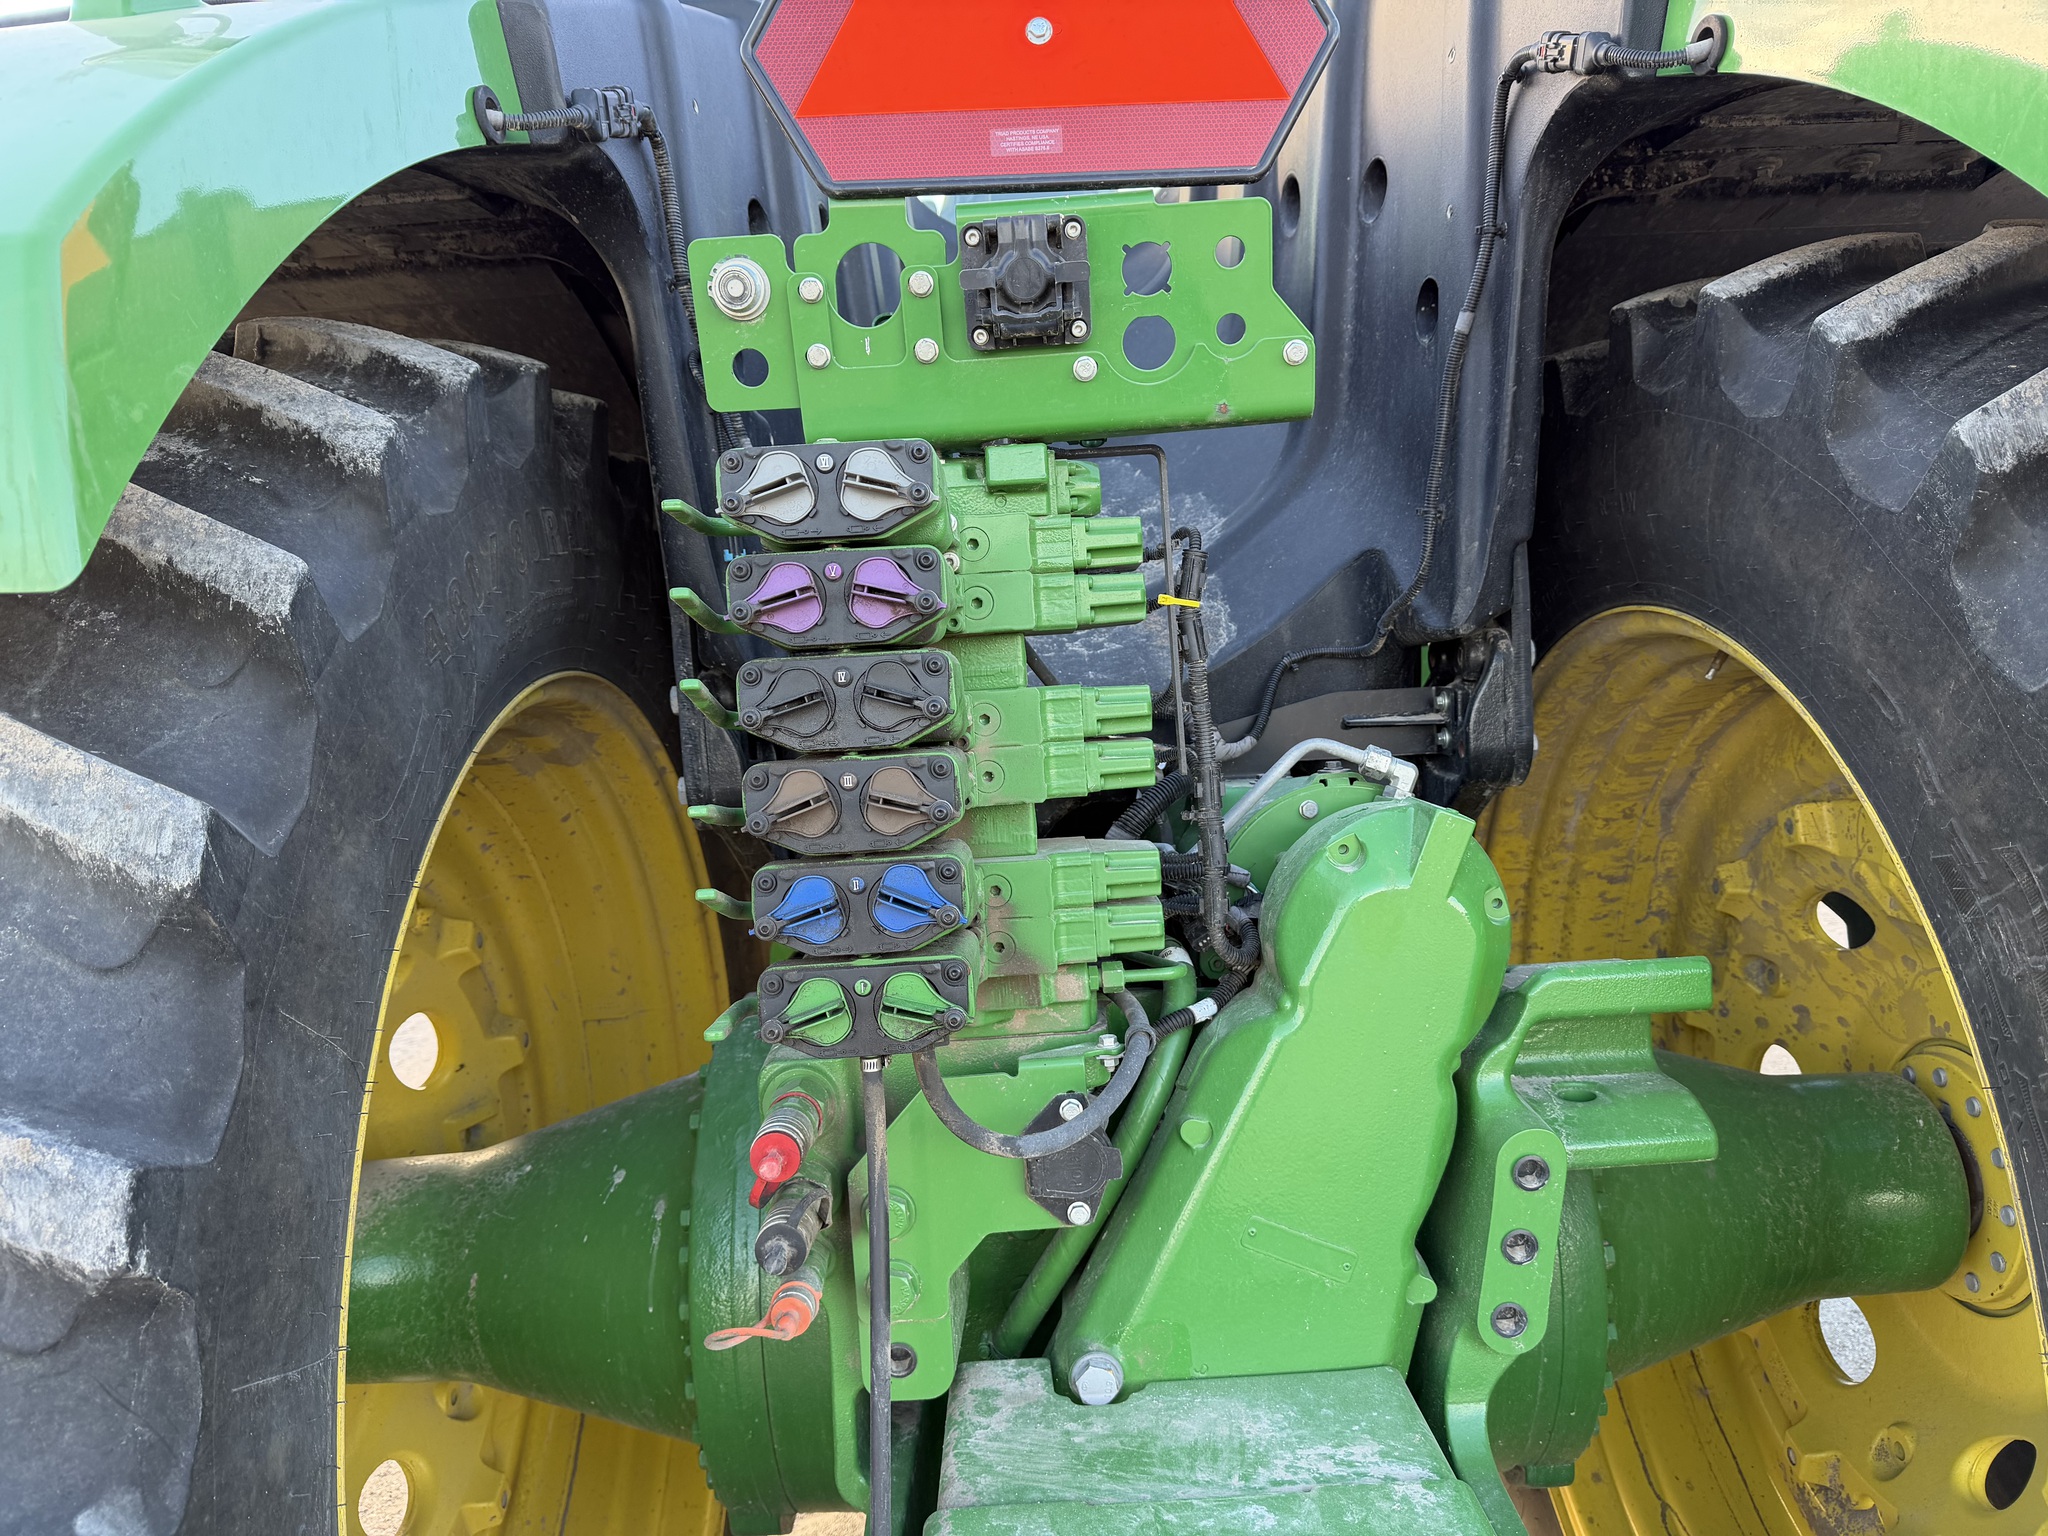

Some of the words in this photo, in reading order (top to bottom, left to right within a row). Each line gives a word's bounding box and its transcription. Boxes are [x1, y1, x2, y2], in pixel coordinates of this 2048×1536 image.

[820, 456, 830, 468] VI
[828, 565, 837, 577] V
[837, 671, 847, 683] IV
[843, 775, 853, 787] III
[852, 879, 860, 891] II
